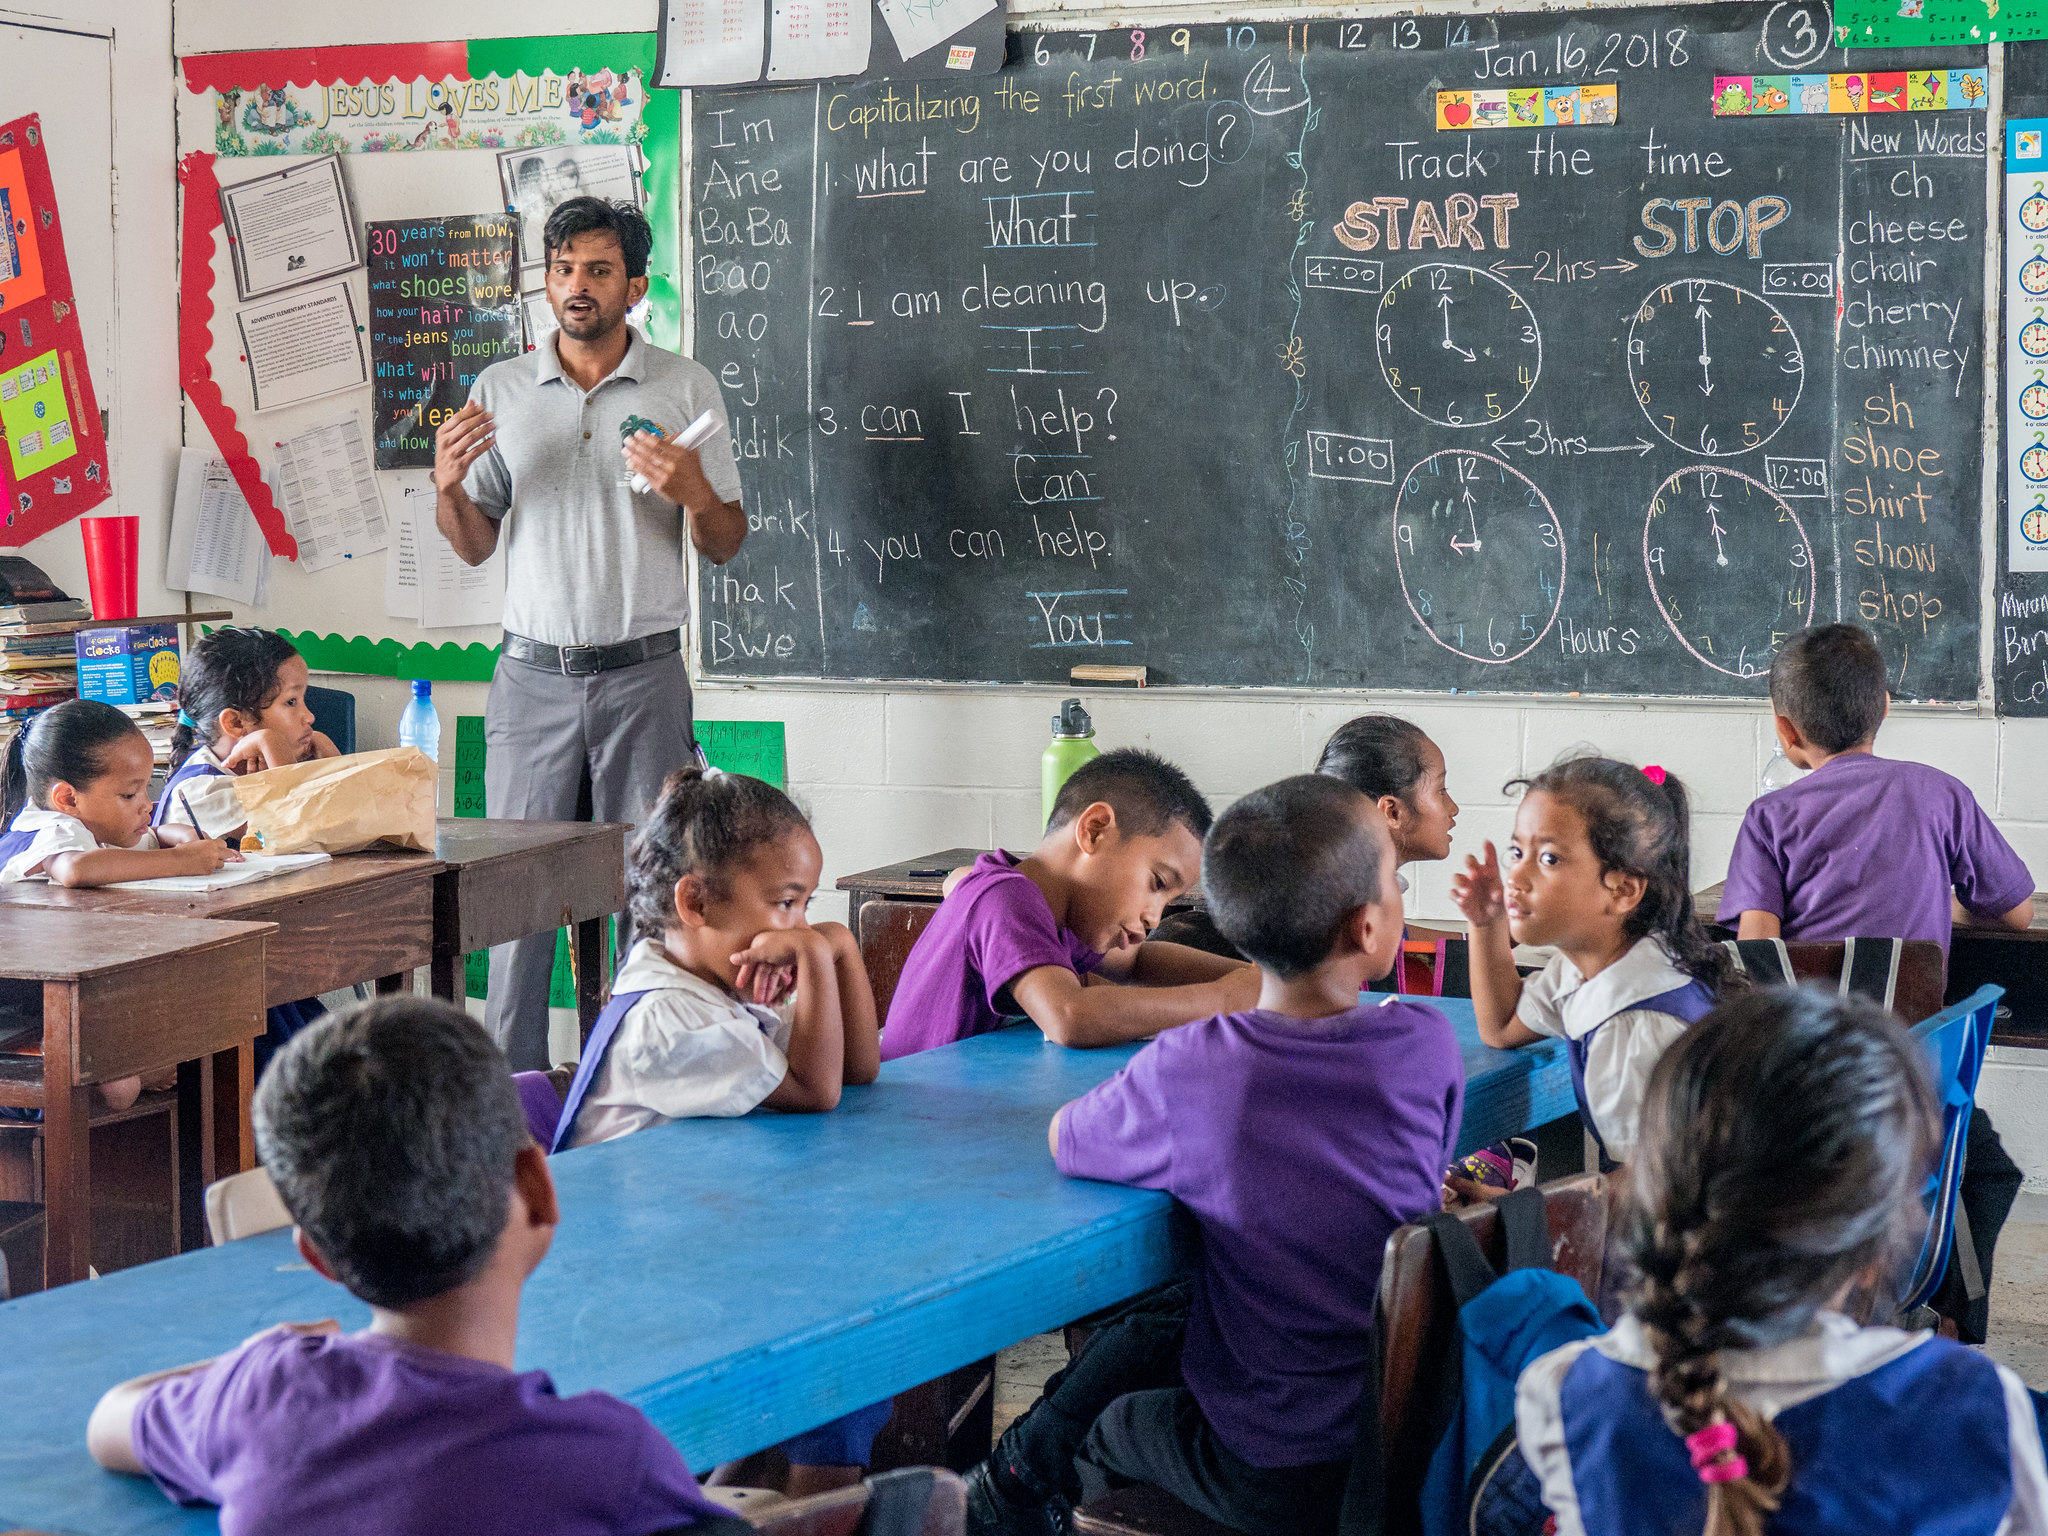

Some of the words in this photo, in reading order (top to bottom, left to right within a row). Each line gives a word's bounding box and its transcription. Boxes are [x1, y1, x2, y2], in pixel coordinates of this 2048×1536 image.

[1033, 34, 1050, 65] 6
[1081, 33, 1099, 61] 7
[1129, 29, 1146, 60] 8
[1171, 28, 1192, 61] 9
[1226, 25, 1256, 51] 10
[1339, 23, 1366, 49] 12
[1392, 20, 1421, 49] 13
[1445, 20, 1475, 48] 14
[1780, 10, 1817, 58] 3
[950, 49, 974, 58] KEEP
[506, 72, 562, 117] ME
[1253, 64, 1291, 103] 4
[827, 82, 981, 135] Capitalizing
[995, 74, 1040, 113] the
[1064, 67, 1124, 115] first
[707, 109, 774, 150] Im
[1851, 116, 1902, 155] New
[1914, 116, 1986, 154] Words
[960, 154, 1011, 185] are
[1036, 146, 1092, 188] you
[1385, 134, 1489, 182] Track
[1528, 131, 1594, 177] the
[1640, 127, 1733, 178] time
[1890, 161, 1933, 199] ch
[986, 194, 1078, 247] What
[1333, 191, 1519, 252] START
[1633, 195, 1792, 259] STOP
[1849, 209, 1968, 247] cheese
[372, 228, 397, 256] 30
[400, 226, 445, 243] years
[448, 230, 472, 239] from
[474, 222, 514, 239] now,
[384, 260, 396, 270] it
[402, 248, 446, 268] won't
[449, 248, 512, 268] matter
[1308, 262, 1378, 285] 4:00
[1534, 250, 1597, 285] 2hrs
[1850, 250, 1937, 285] chair
[372, 280, 397, 290] what
[400, 274, 467, 298] shoes
[470, 274, 488, 285] you
[1430, 268, 1452, 291] 12
[1688, 280, 1713, 303] 12
[1769, 268, 1831, 289] 6:00
[251, 313, 276, 324] ADVENTIST
[276, 304, 307, 318] ELEMENTARY
[307, 296, 337, 309] STANDARDS
[892, 284, 940, 318] am
[961, 263, 1107, 332] cleaning
[376, 307, 394, 318] how
[396, 307, 419, 318] your
[421, 304, 464, 325] hair
[468, 310, 510, 323] looked
[1845, 290, 1962, 344] cherry
[374, 332, 386, 342] or
[388, 335, 404, 344] the
[404, 330, 449, 348] jeans
[454, 328, 474, 340] you
[452, 338, 517, 358] bought.
[1378, 323, 1392, 354] 9
[1520, 325, 1537, 344] 3
[1629, 338, 1644, 366] 9
[1779, 350, 1804, 374] 3
[1843, 334, 1970, 398] chimney
[376, 360, 415, 378] What
[421, 362, 454, 382] will
[382, 388, 394, 399] is
[398, 387, 431, 400] what
[1863, 382, 1915, 429] sh
[393, 408, 413, 420] you
[860, 404, 922, 436] can
[948, 390, 981, 435] I
[1010, 386, 1119, 455] help?
[1447, 401, 1463, 425] 6
[379, 438, 396, 449] and
[400, 434, 429, 450] how
[1314, 437, 1388, 471] 9:00
[1524, 420, 1589, 456] 3hrs
[1700, 423, 1717, 455] 6
[1843, 426, 1945, 477] shoe
[1012, 453, 1091, 505] Can
[1457, 456, 1480, 484] 12
[1700, 471, 1723, 499] 12
[1772, 463, 1825, 491] 12:00
[1844, 475, 1933, 524] shirt
[1398, 524, 1414, 556] 9
[1538, 522, 1558, 548] 3
[1853, 521, 1937, 573] show
[864, 532, 922, 584] you
[949, 526, 1005, 559] can
[1649, 546, 1666, 576] 9
[1789, 543, 1808, 568] 3
[1034, 591, 1105, 646] You
[1858, 573, 1943, 638] shop
[86, 645, 120, 657] Clocks
[711, 620, 797, 666] Bwe
[1488, 617, 1506, 657] 6
[1558, 617, 1641, 656] Hours
[1738, 645, 1755, 680] 6
